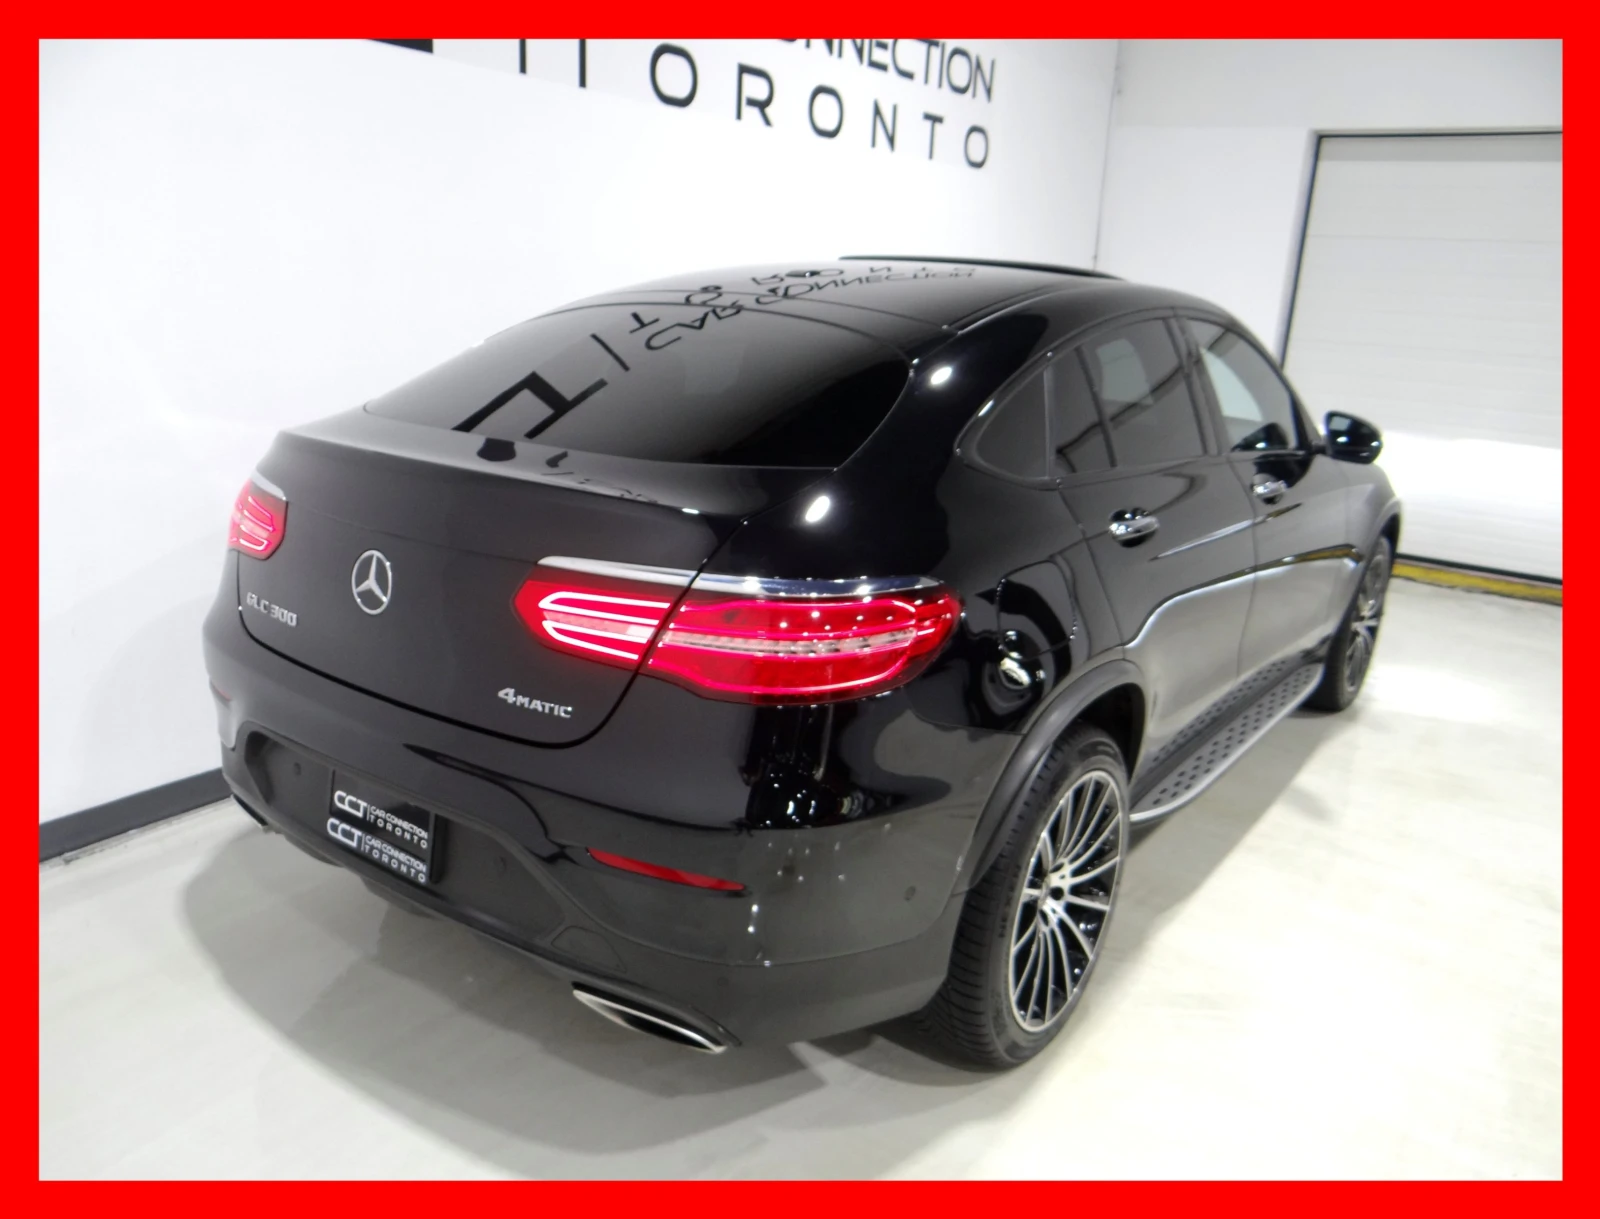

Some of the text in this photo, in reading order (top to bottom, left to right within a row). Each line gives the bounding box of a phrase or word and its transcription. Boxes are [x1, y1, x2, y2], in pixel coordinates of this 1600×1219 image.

[246, 591, 297, 627] GLC 300
[497, 687, 572, 718] 4MATIC
[333, 790, 367, 818] CCT
[327, 817, 362, 848] CCT
[369, 814, 428, 849] TORONTO
[370, 805, 428, 840] CAR CONNECTION
[364, 844, 427, 884] TORONTO
[365, 835, 427, 873] CAR CONNECTION
